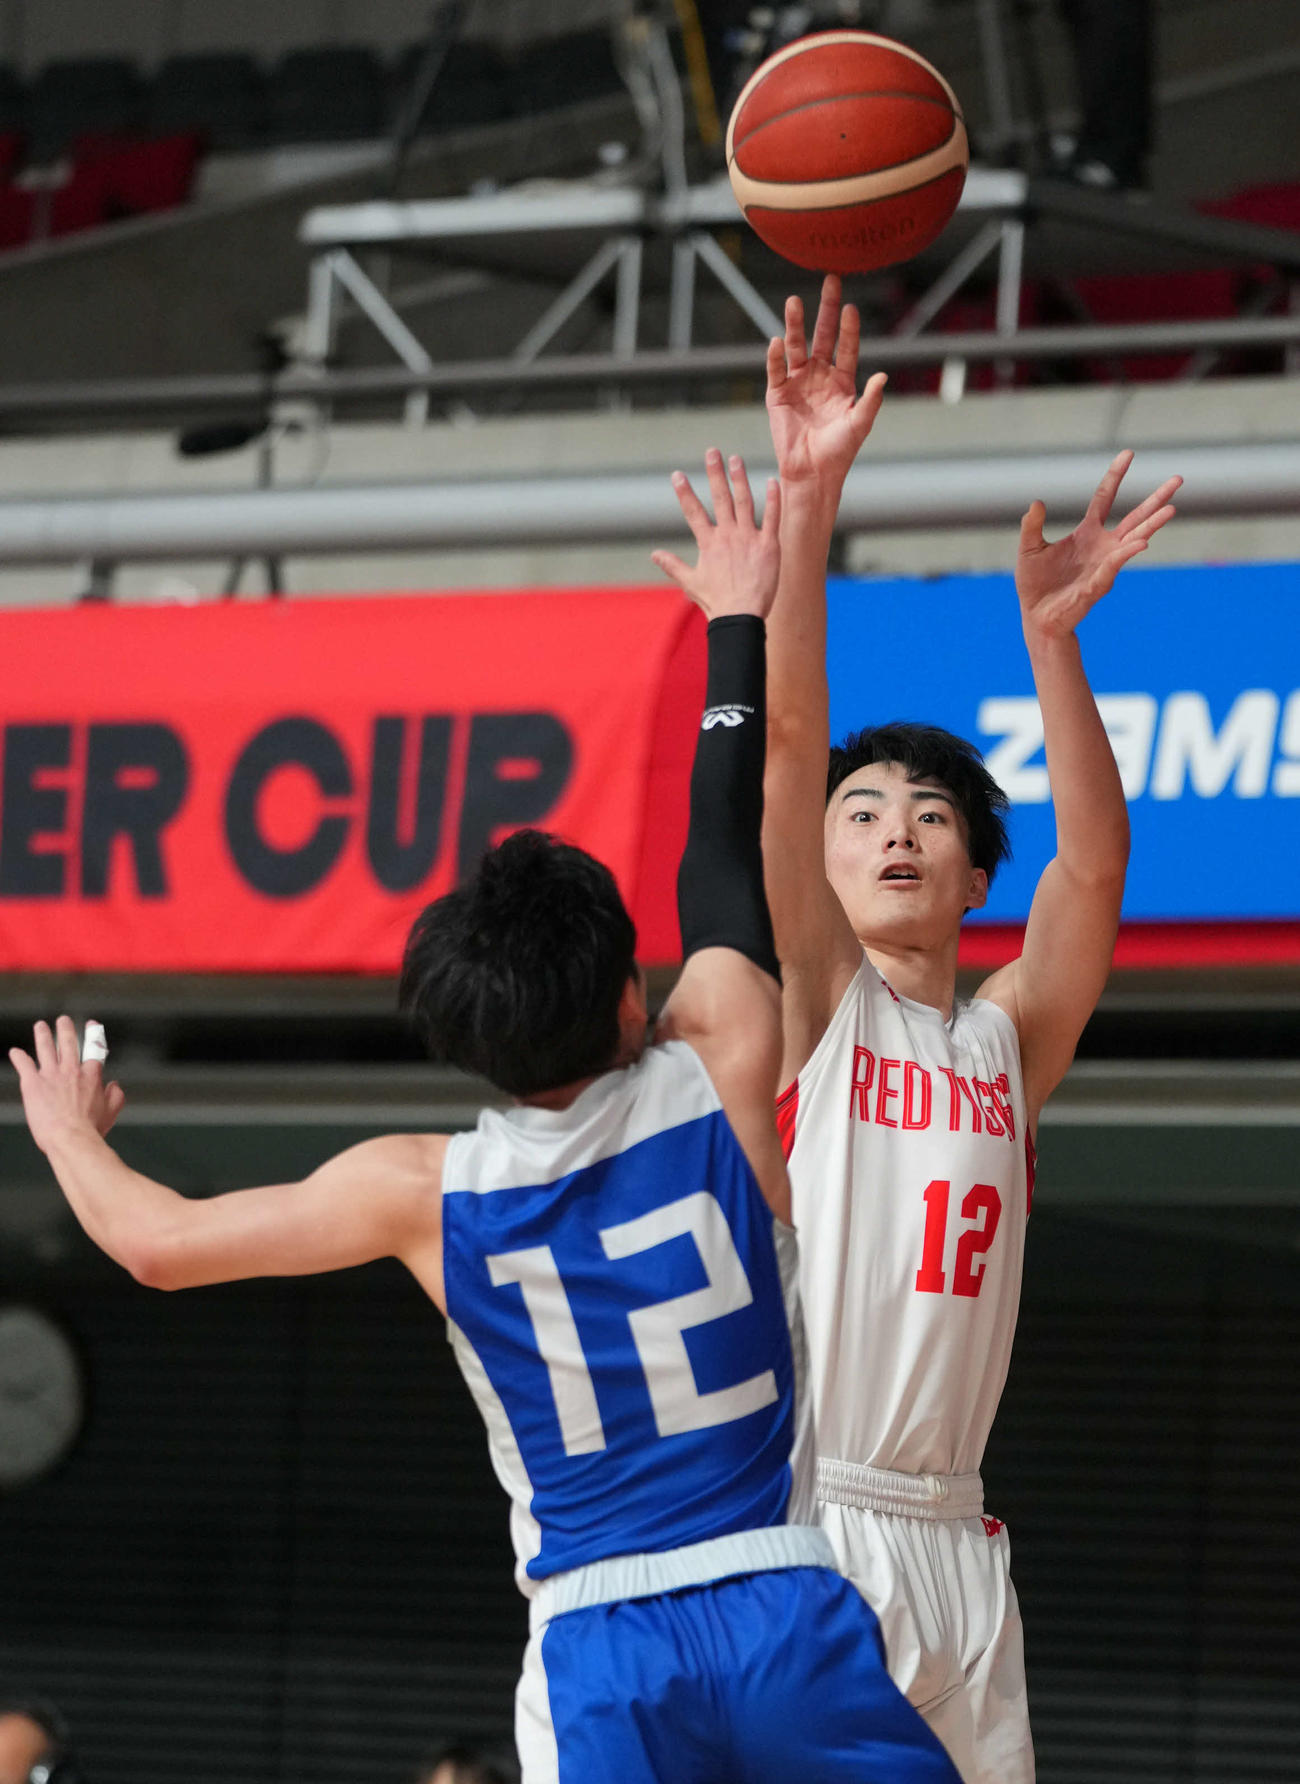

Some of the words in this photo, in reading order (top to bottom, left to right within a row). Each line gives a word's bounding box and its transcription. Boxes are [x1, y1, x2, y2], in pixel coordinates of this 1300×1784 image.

[808, 216, 916, 249] molten
[1, 719, 193, 898] ER
[222, 712, 577, 900] CUP
[849, 1044, 932, 1131] RED
[915, 1180, 1002, 1298] 12
[486, 1190, 779, 1457] 12
